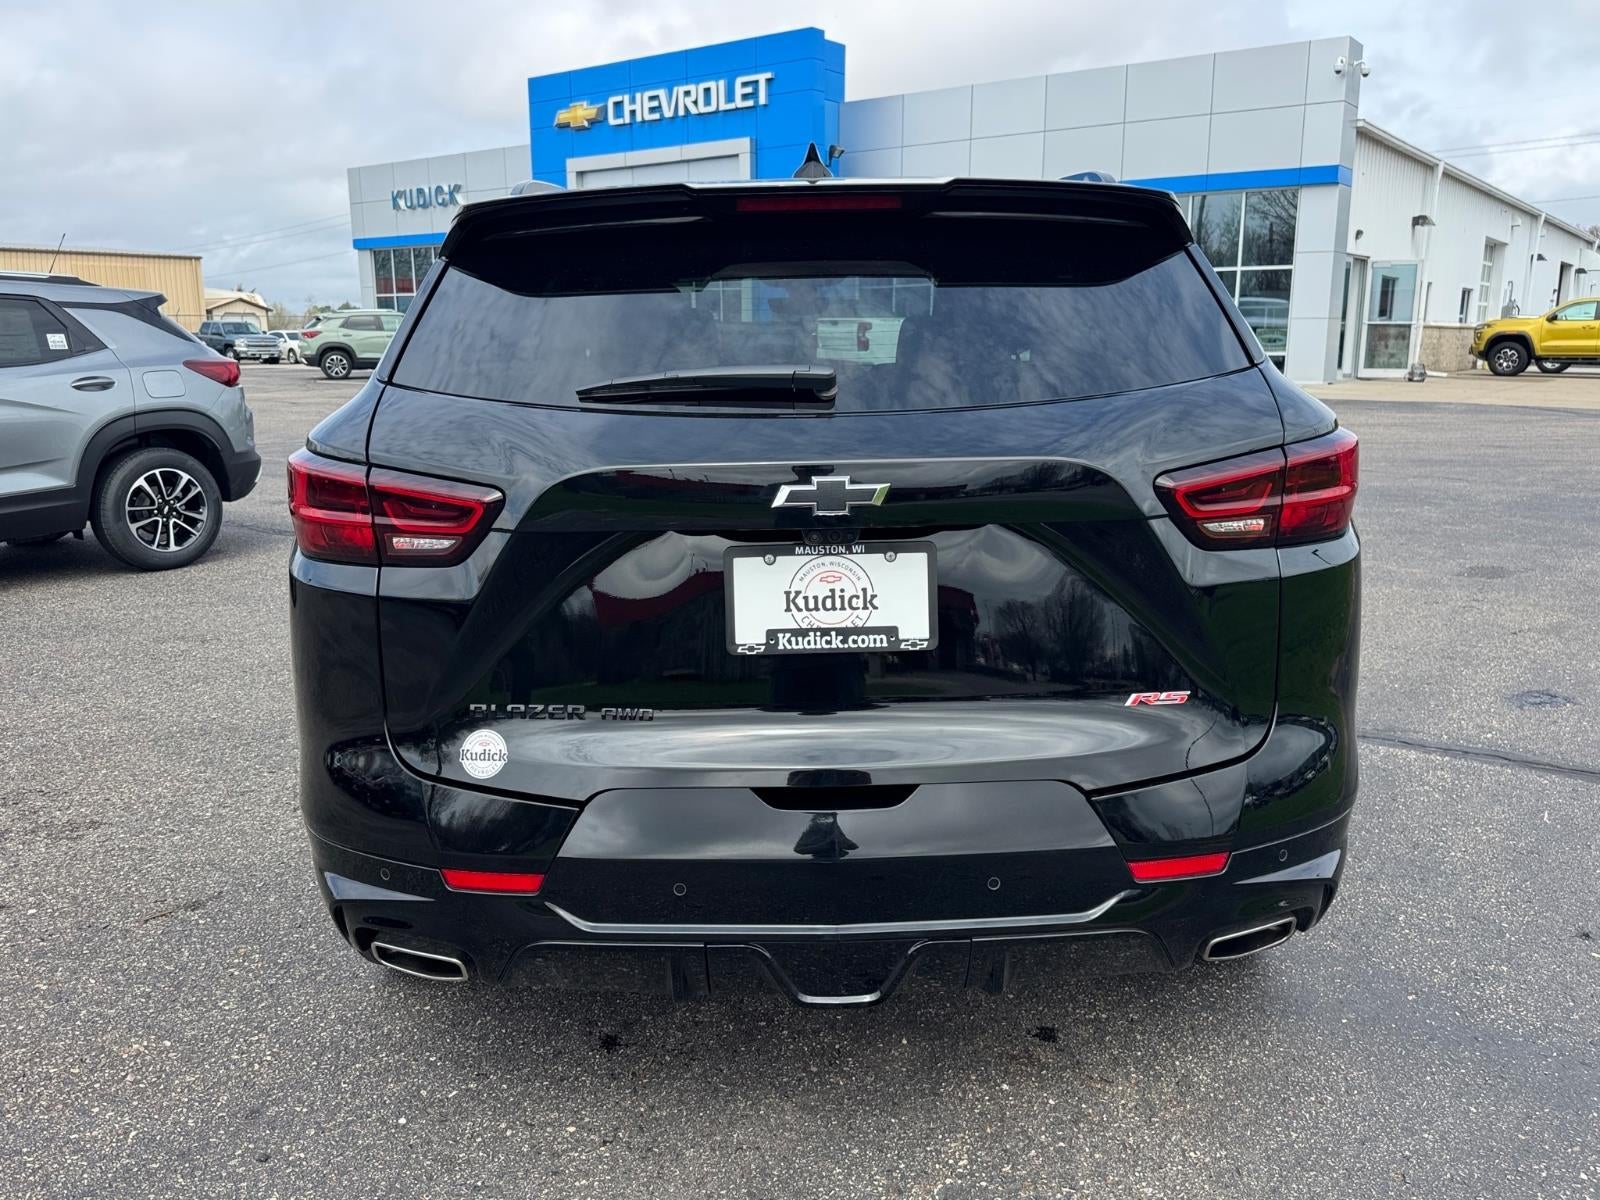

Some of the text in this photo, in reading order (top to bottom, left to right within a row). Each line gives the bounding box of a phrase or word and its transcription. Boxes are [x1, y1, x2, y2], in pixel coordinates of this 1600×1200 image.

[607, 72, 775, 126] CHEVROLET
[391, 184, 462, 211] KUDICK
[795, 544, 865, 555] MAUSTON, WI
[799, 561, 862, 582] MAUSTON, WISCONSIN
[784, 587, 879, 613] Kudick
[777, 631, 888, 650] Kudick.com
[1124, 690, 1191, 706] RS
[469, 703, 655, 722] BLAZER AWD
[461, 749, 507, 762] Kudick
